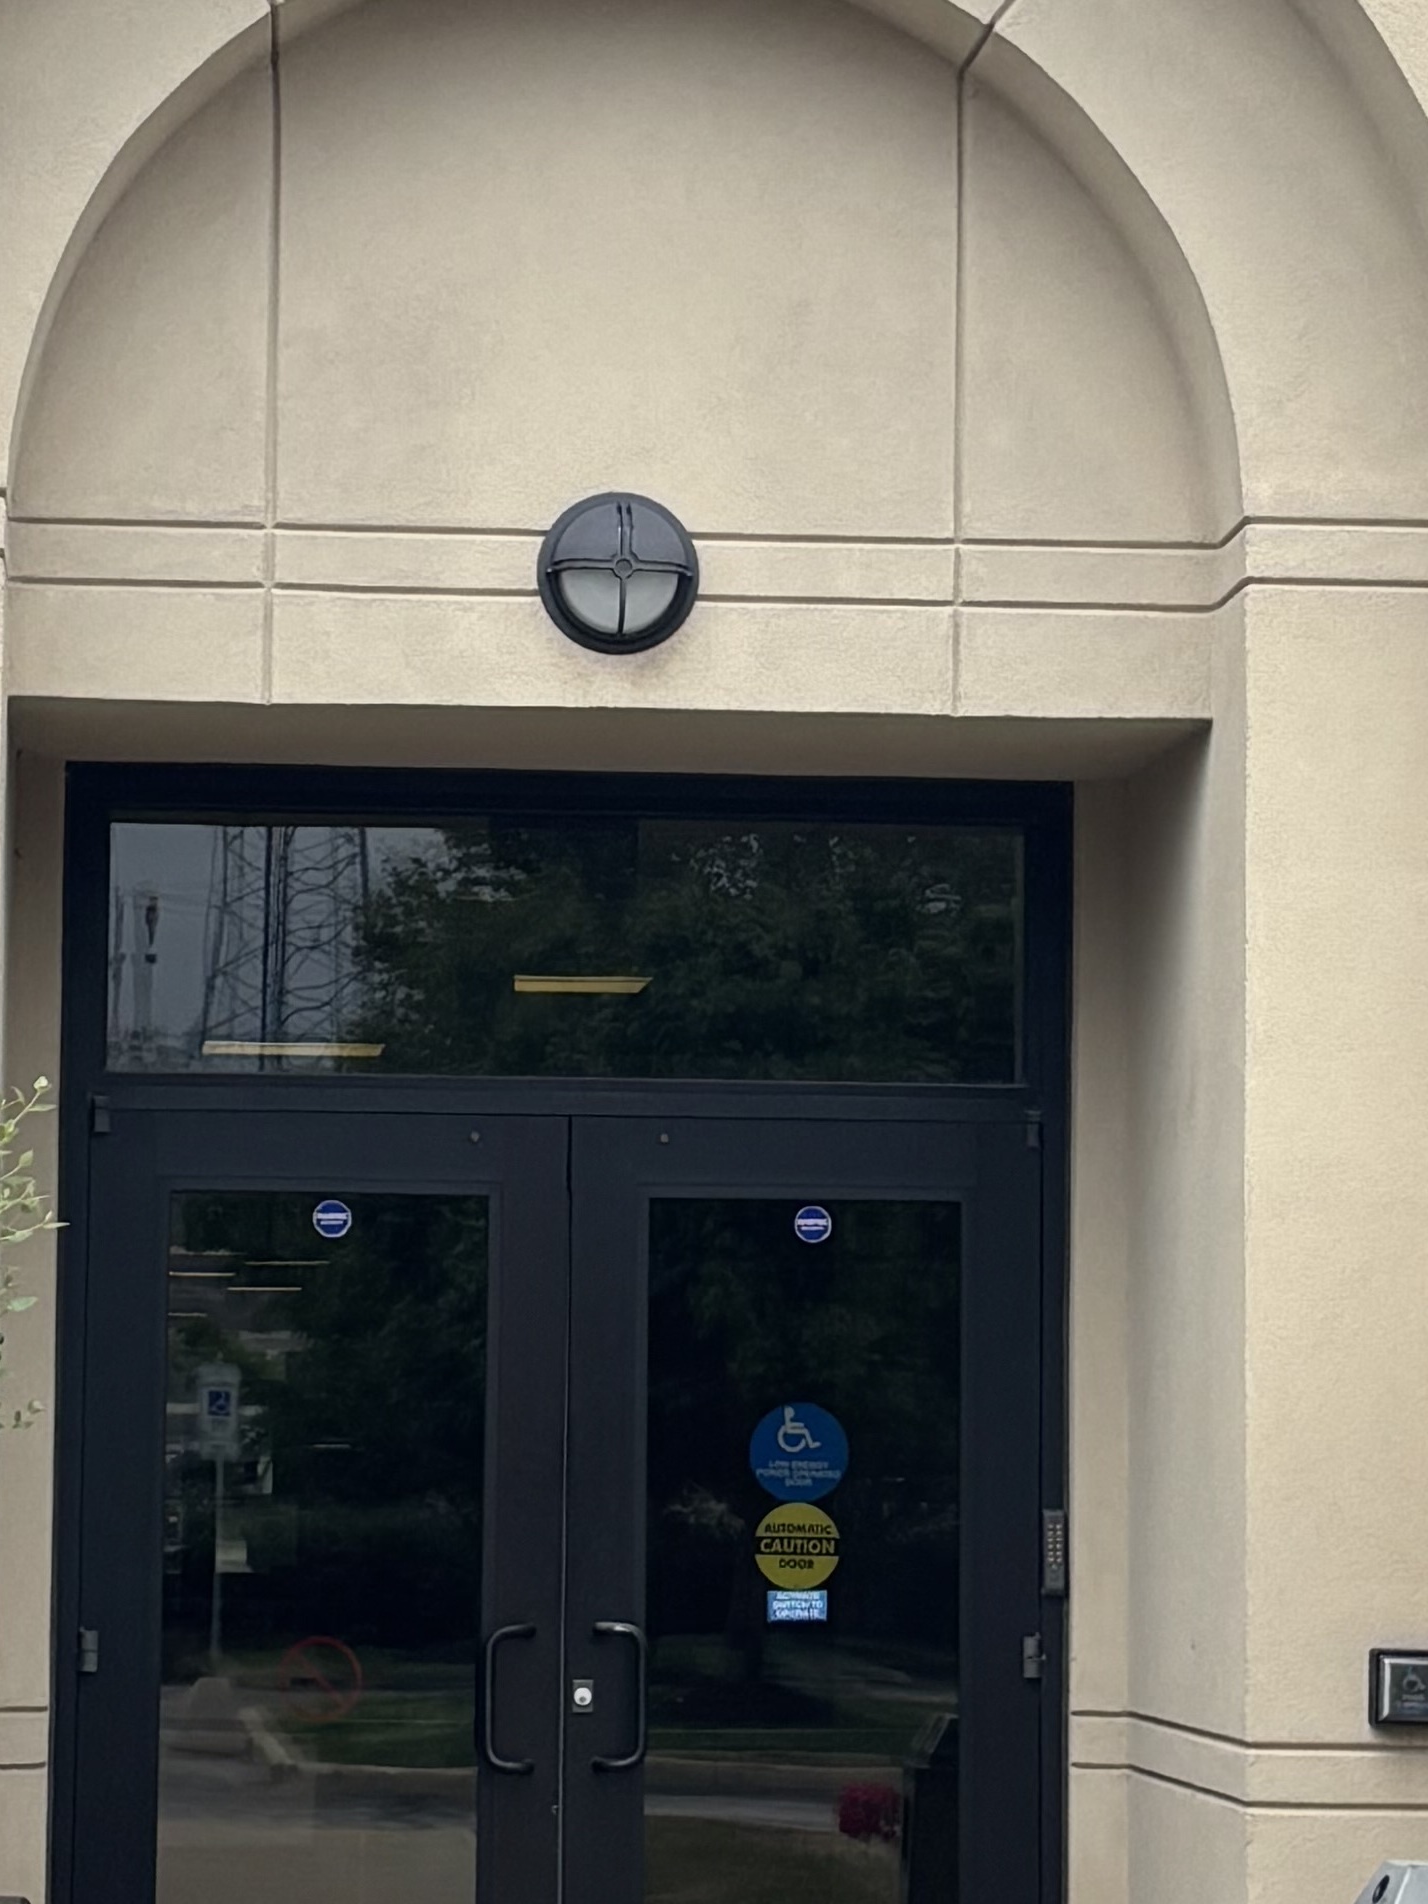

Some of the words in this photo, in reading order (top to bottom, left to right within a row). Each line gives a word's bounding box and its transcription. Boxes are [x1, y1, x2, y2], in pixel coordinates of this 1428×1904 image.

[765, 1522, 832, 1535] AUTOMATIC
[760, 1538, 835, 1554] CAUTION
[778, 1558, 815, 1569] DOOR
